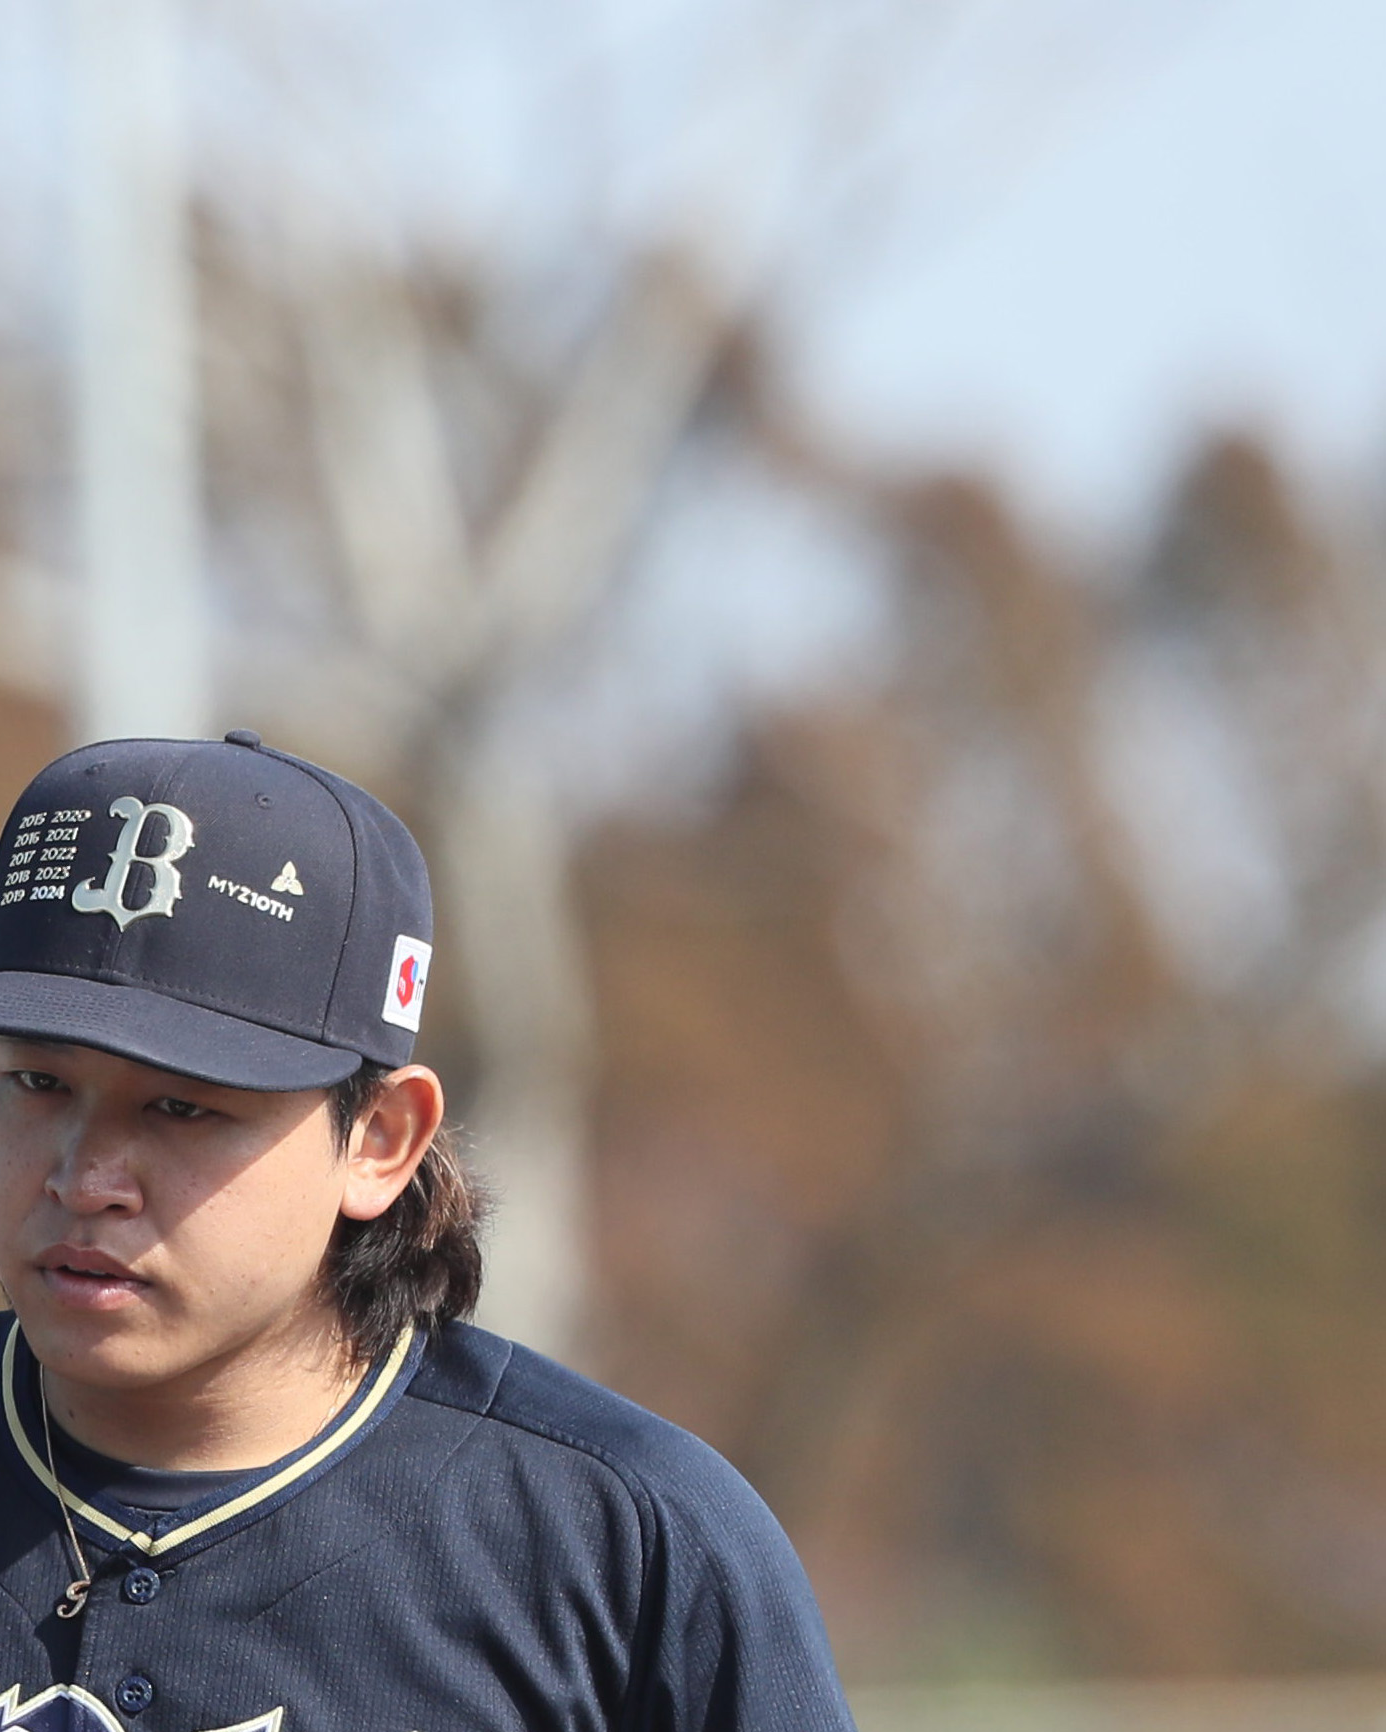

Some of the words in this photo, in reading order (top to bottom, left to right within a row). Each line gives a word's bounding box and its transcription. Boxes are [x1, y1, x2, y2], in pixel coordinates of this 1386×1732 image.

[19, 812, 47, 829] 2015
[51, 810, 92, 823] 2020
[14, 831, 40, 848] 2016
[45, 827, 79, 842] 2021
[9, 850, 36, 868] 2017
[40, 847, 77, 862] 2022
[72, 796, 196, 933] B
[4, 869, 30, 887] 2018
[34, 866, 71, 881] 2023
[0, 889, 25, 907] 2019
[29, 885, 65, 900] 2024
[207, 875, 294, 922] MYZ10TH
